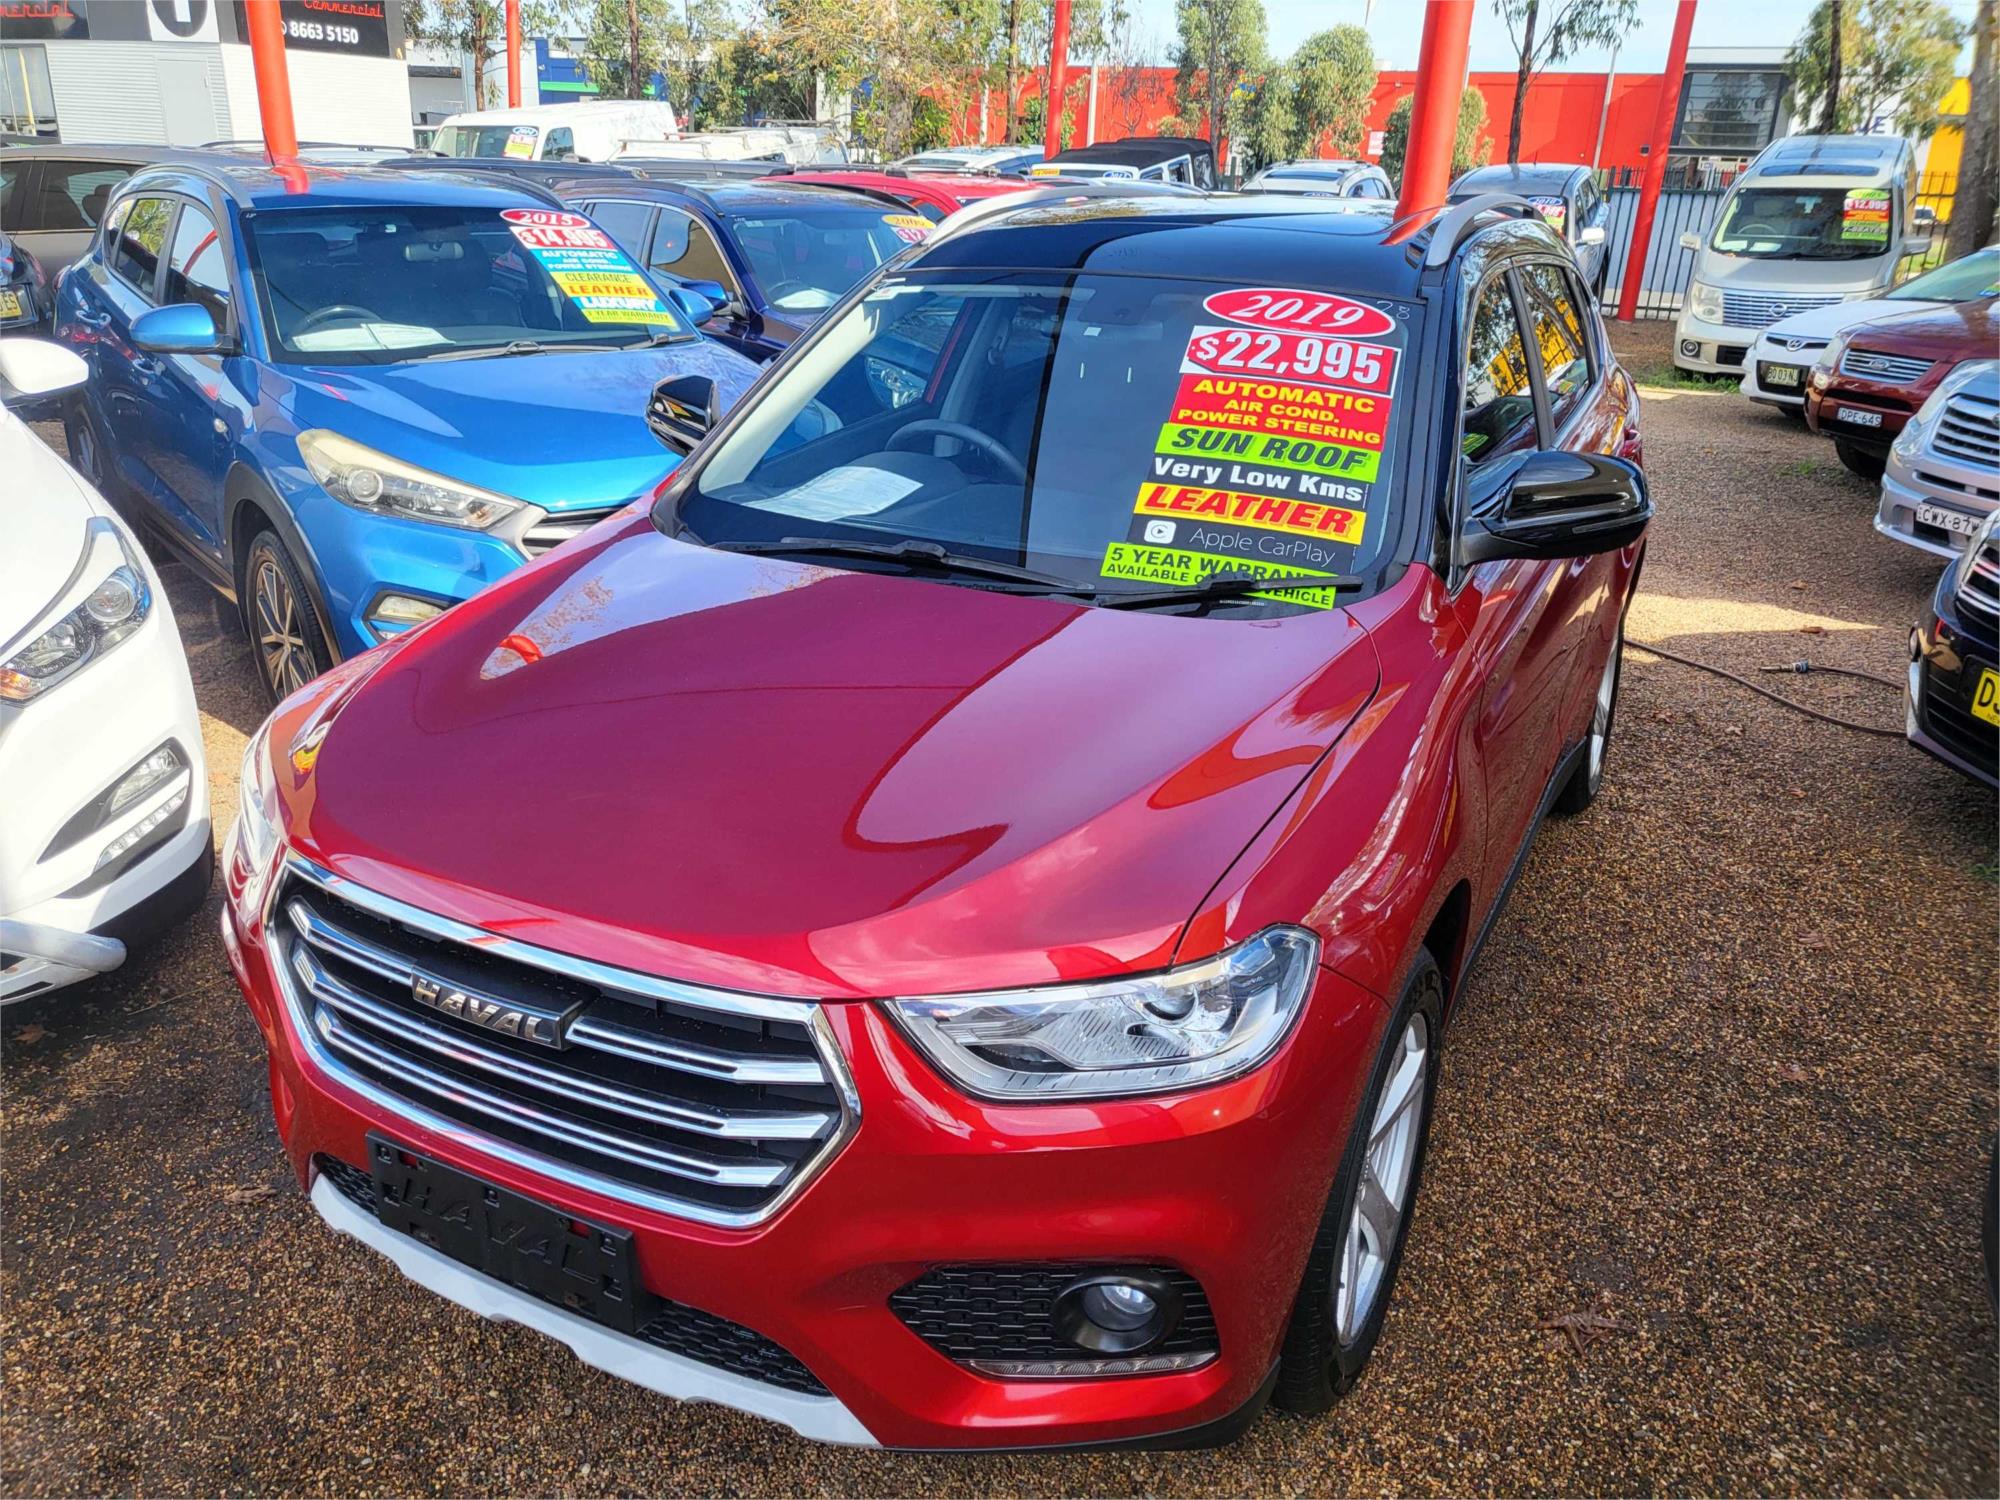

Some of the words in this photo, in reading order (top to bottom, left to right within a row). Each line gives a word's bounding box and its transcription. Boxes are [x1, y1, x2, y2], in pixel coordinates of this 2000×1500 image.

[304, 0, 384, 18] Commercial
[289, 20, 323, 40] 8663
[326, 25, 359, 44] 5150
[519, 212, 573, 226] 2015
[519, 229, 608, 248] $14,995
[542, 250, 618, 260] AUTOMATIC
[565, 272, 632, 283] CLEARANCE
[569, 283, 649, 296] LEATHER
[579, 297, 656, 311] LUXURY
[1228, 295, 1366, 328] 2019
[1196, 331, 1384, 384] $22,995
[1193, 379, 1376, 413] AUTOMATIC
[1223, 399, 1264, 413] AIR
[1270, 404, 1340, 423] COND.
[1177, 409, 1258, 427] POWER
[1265, 417, 1381, 444] STEERING
[1171, 428, 1254, 455] SUN
[1259, 437, 1369, 472] ROOF
[1154, 457, 1222, 485] Very
[1229, 465, 1291, 490] Low
[1298, 474, 1364, 502] Kms
[1144, 486, 1354, 535] LEATHER
[1189, 527, 1253, 551] Apple
[1258, 536, 1336, 568] CarPlay
[1106, 563, 1189, 583] AVAILABLE
[1263, 587, 1330, 606] VEHICLE
[1111, 546, 1123, 561] 5
[1131, 549, 1192, 570] YEAR
[1199, 557, 1331, 592] WARRAN
[1978, 677, 2000, 715] D
[415, 977, 552, 1043] HAVAL
[402, 1177, 599, 1285] HAVAL
